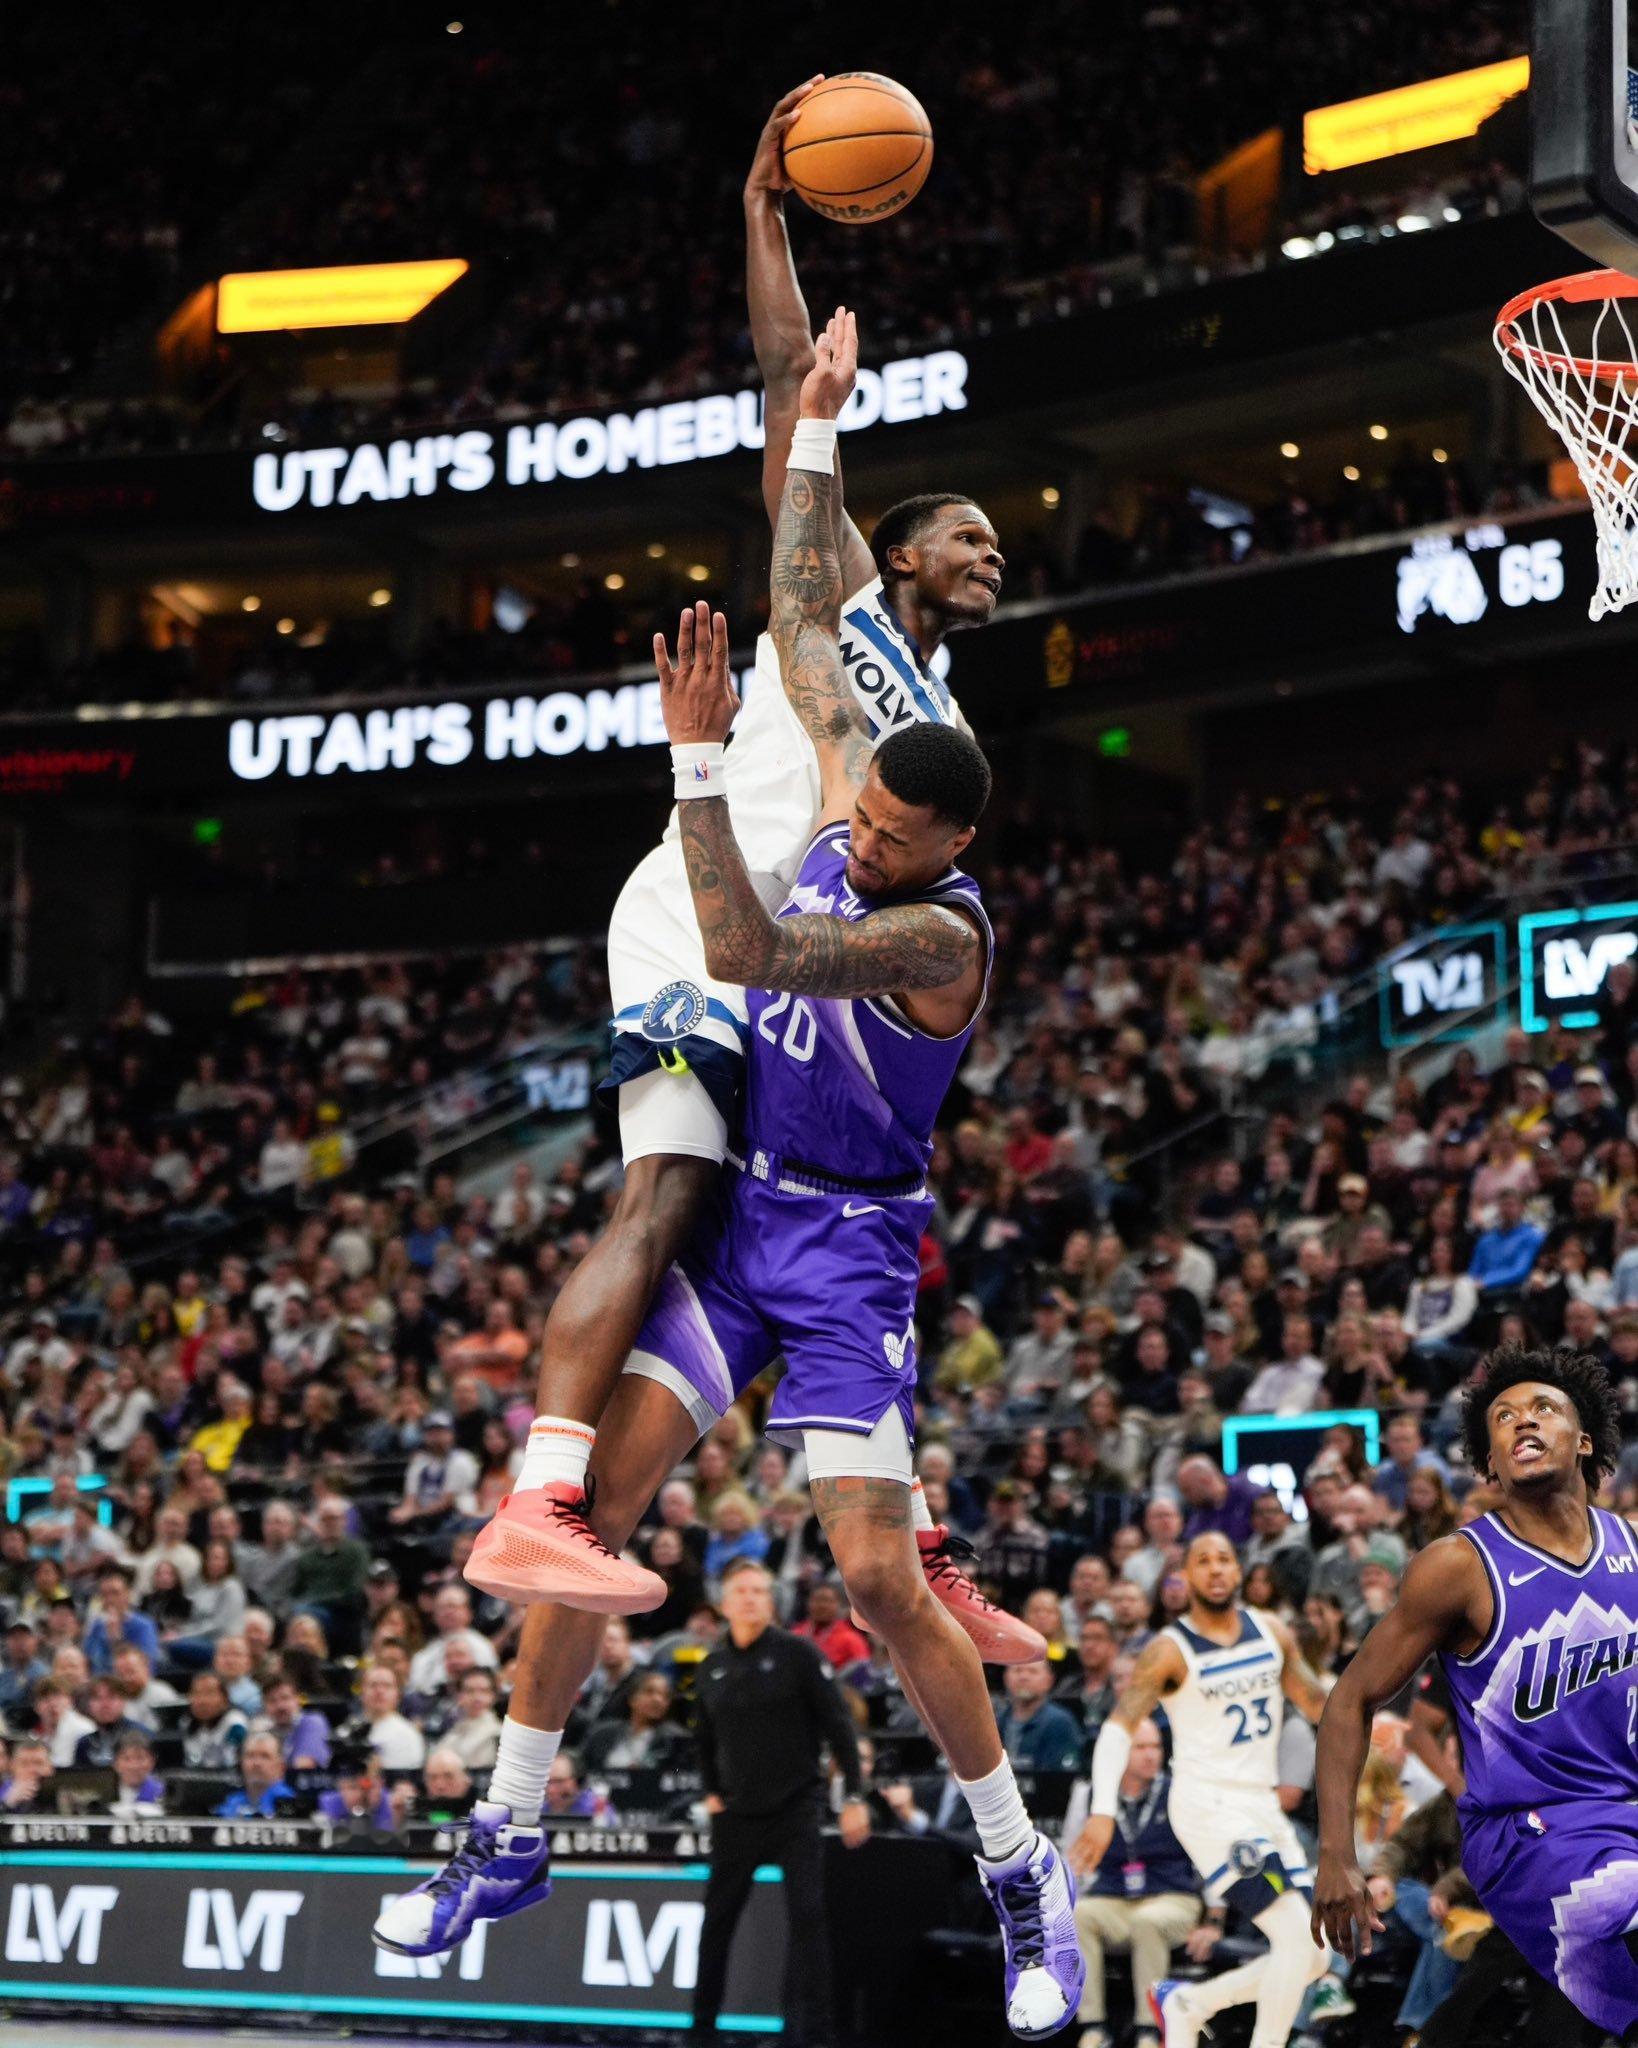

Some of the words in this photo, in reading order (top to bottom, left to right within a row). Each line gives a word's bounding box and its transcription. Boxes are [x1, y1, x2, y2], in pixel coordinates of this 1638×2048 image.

[252, 430, 495, 511] UTAH'S
[506, 349, 970, 486] HOMEBUDER
[1499, 538, 1565, 607] 65
[839, 632, 919, 726] WOLV
[228, 701, 474, 780] UTAH'S
[757, 989, 818, 1063] 20
[1604, 1556, 1635, 1574] LVT
[1199, 1669, 1280, 1702] WOLVES
[1224, 1696, 1272, 1748] 23
[28, 1823, 90, 1842] DELTA
[128, 1825, 193, 1844] DELTA
[232, 1827, 300, 1846] DELTA
[573, 1831, 648, 1853] DELTA
[6, 1883, 120, 1965] LVT
[182, 1888, 305, 1973] LVT
